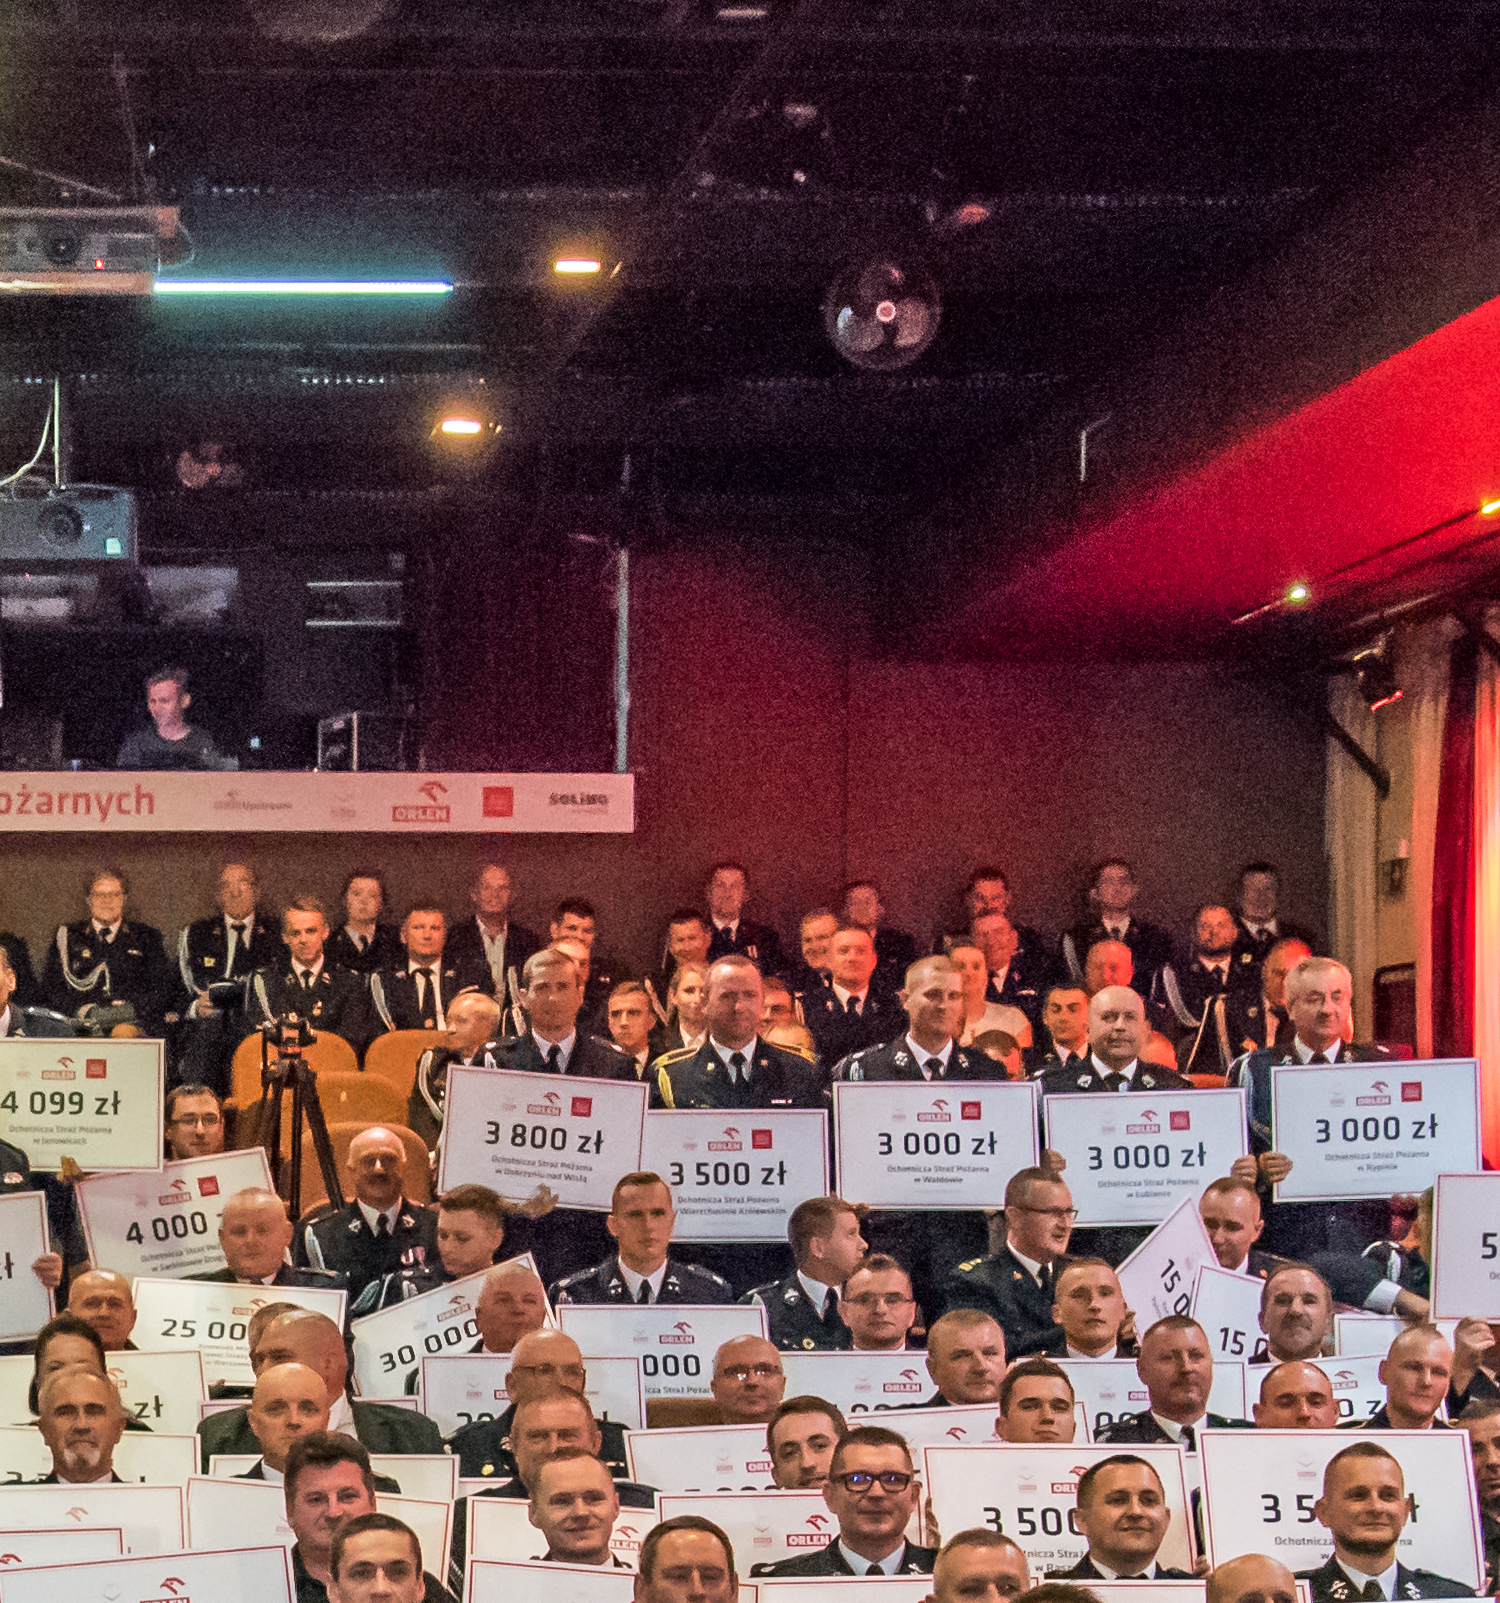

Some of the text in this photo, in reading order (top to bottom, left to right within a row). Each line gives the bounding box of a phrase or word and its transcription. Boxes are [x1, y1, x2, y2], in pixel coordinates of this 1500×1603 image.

[393, 807, 448, 821] ORLEN
[0, 1090, 121, 1115] 4 099 zł
[485, 1121, 604, 1154] 3 800 zł
[1316, 1114, 1438, 1143] 3 000 zł
[878, 1131, 997, 1155] 3 000 zł
[1088, 1142, 1206, 1170] 3 000 zł
[670, 1161, 787, 1186] 3 500 zł
[1482, 1233, 1497, 1259] 5
